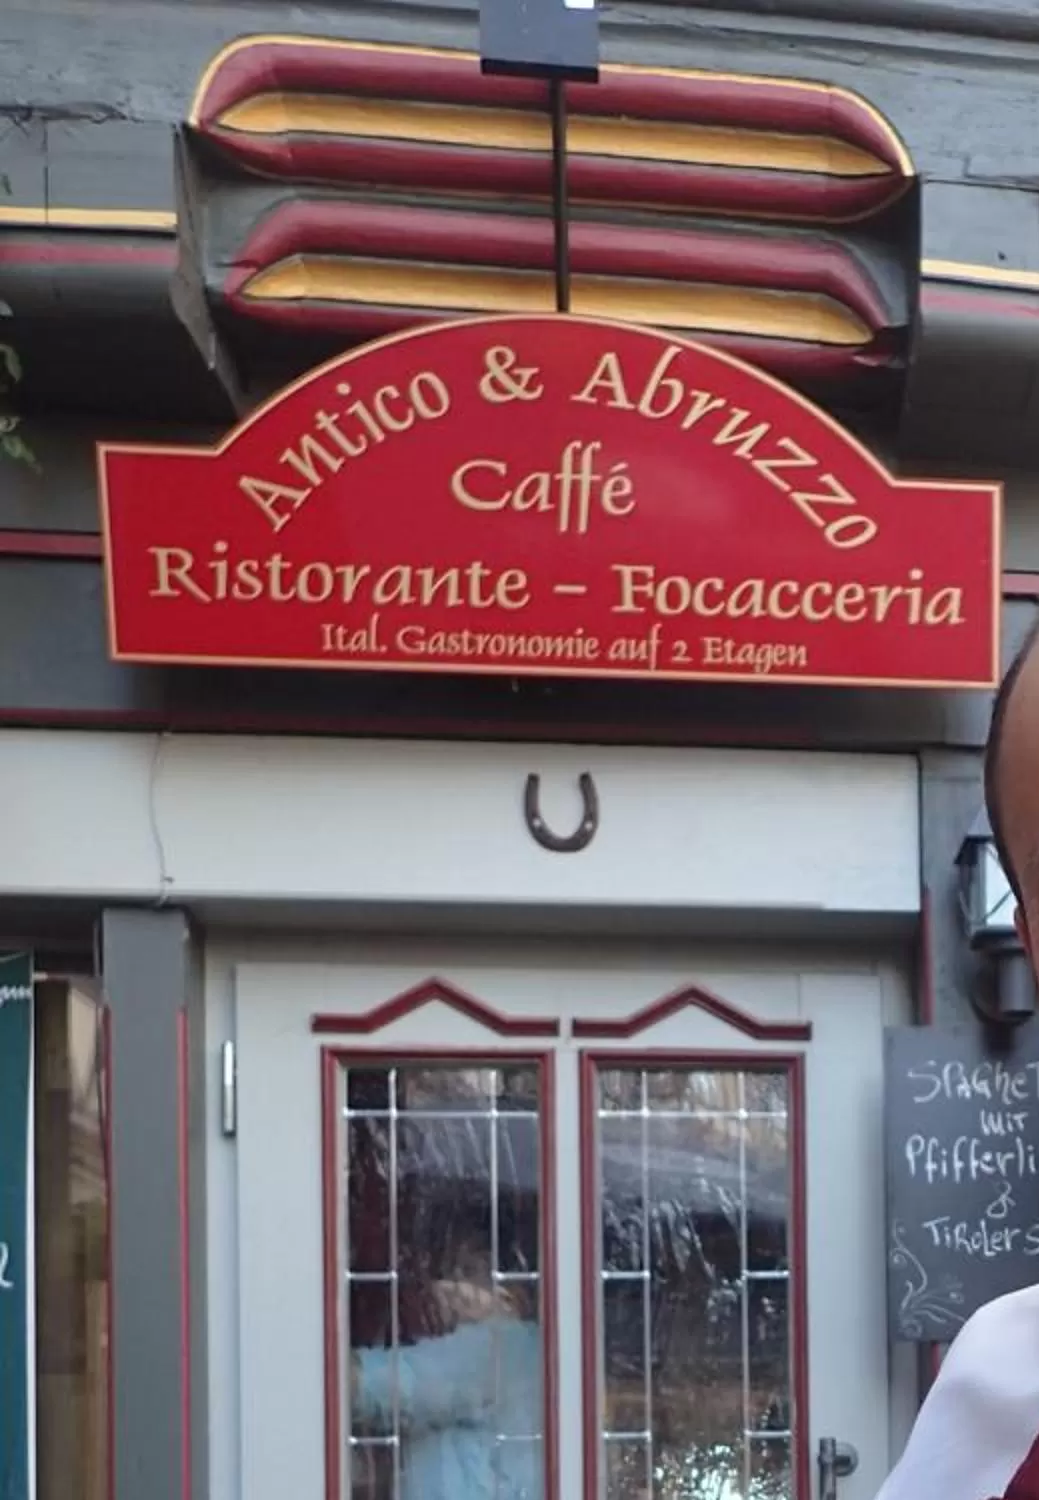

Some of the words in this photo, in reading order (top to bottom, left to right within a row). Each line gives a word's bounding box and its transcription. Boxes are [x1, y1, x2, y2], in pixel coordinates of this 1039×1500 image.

[239, 371, 450, 532] Antico
[479, 345, 544, 403] &
[571, 344, 878, 549] Abruzzo
[451, 440, 636, 534] Caffé
[148, 541, 530, 609] Ristorante
[610, 563, 966, 626] Focacceria
[320, 611, 388, 653] Ital.
[395, 624, 600, 661] Gastronomie
[608, 622, 663, 671] auf
[670, 639, 693, 663] 2
[702, 636, 808, 674] Etagen
